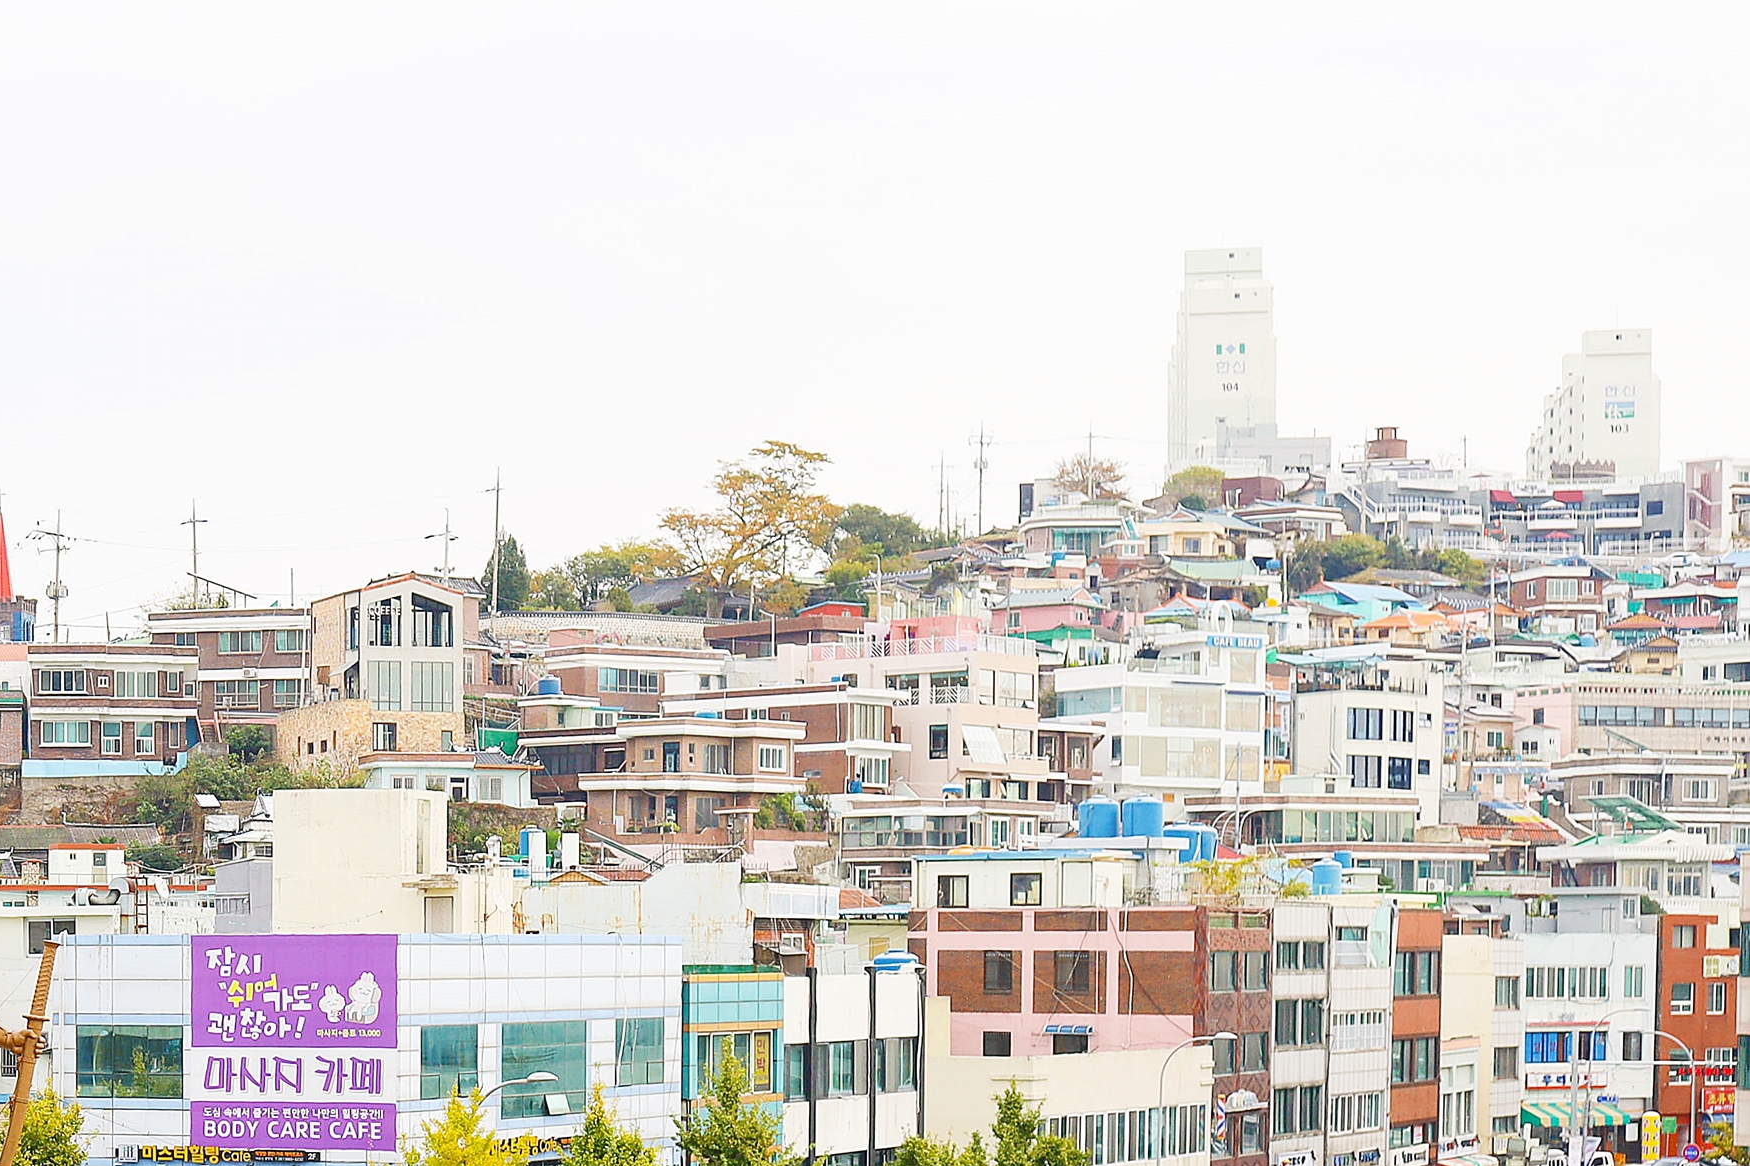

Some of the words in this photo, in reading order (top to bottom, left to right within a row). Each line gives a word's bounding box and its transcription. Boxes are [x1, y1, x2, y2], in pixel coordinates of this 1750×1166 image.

[1222, 382, 1239, 391] 104
[1610, 424, 1630, 433] 103
[206, 946, 262, 977] 잠시
[207, 1007, 306, 1042] 괜찮아!
[204, 1056, 302, 1094] 마사지
[315, 1056, 382, 1094] 카페
[203, 1108, 221, 1118] 도심
[204, 1121, 259, 1138] BODY
[268, 1121, 322, 1139] CARE
[329, 1121, 382, 1140] CAFE
[142, 1146, 221, 1164] 미스터힐링
[222, 1147, 251, 1163] Cafe
